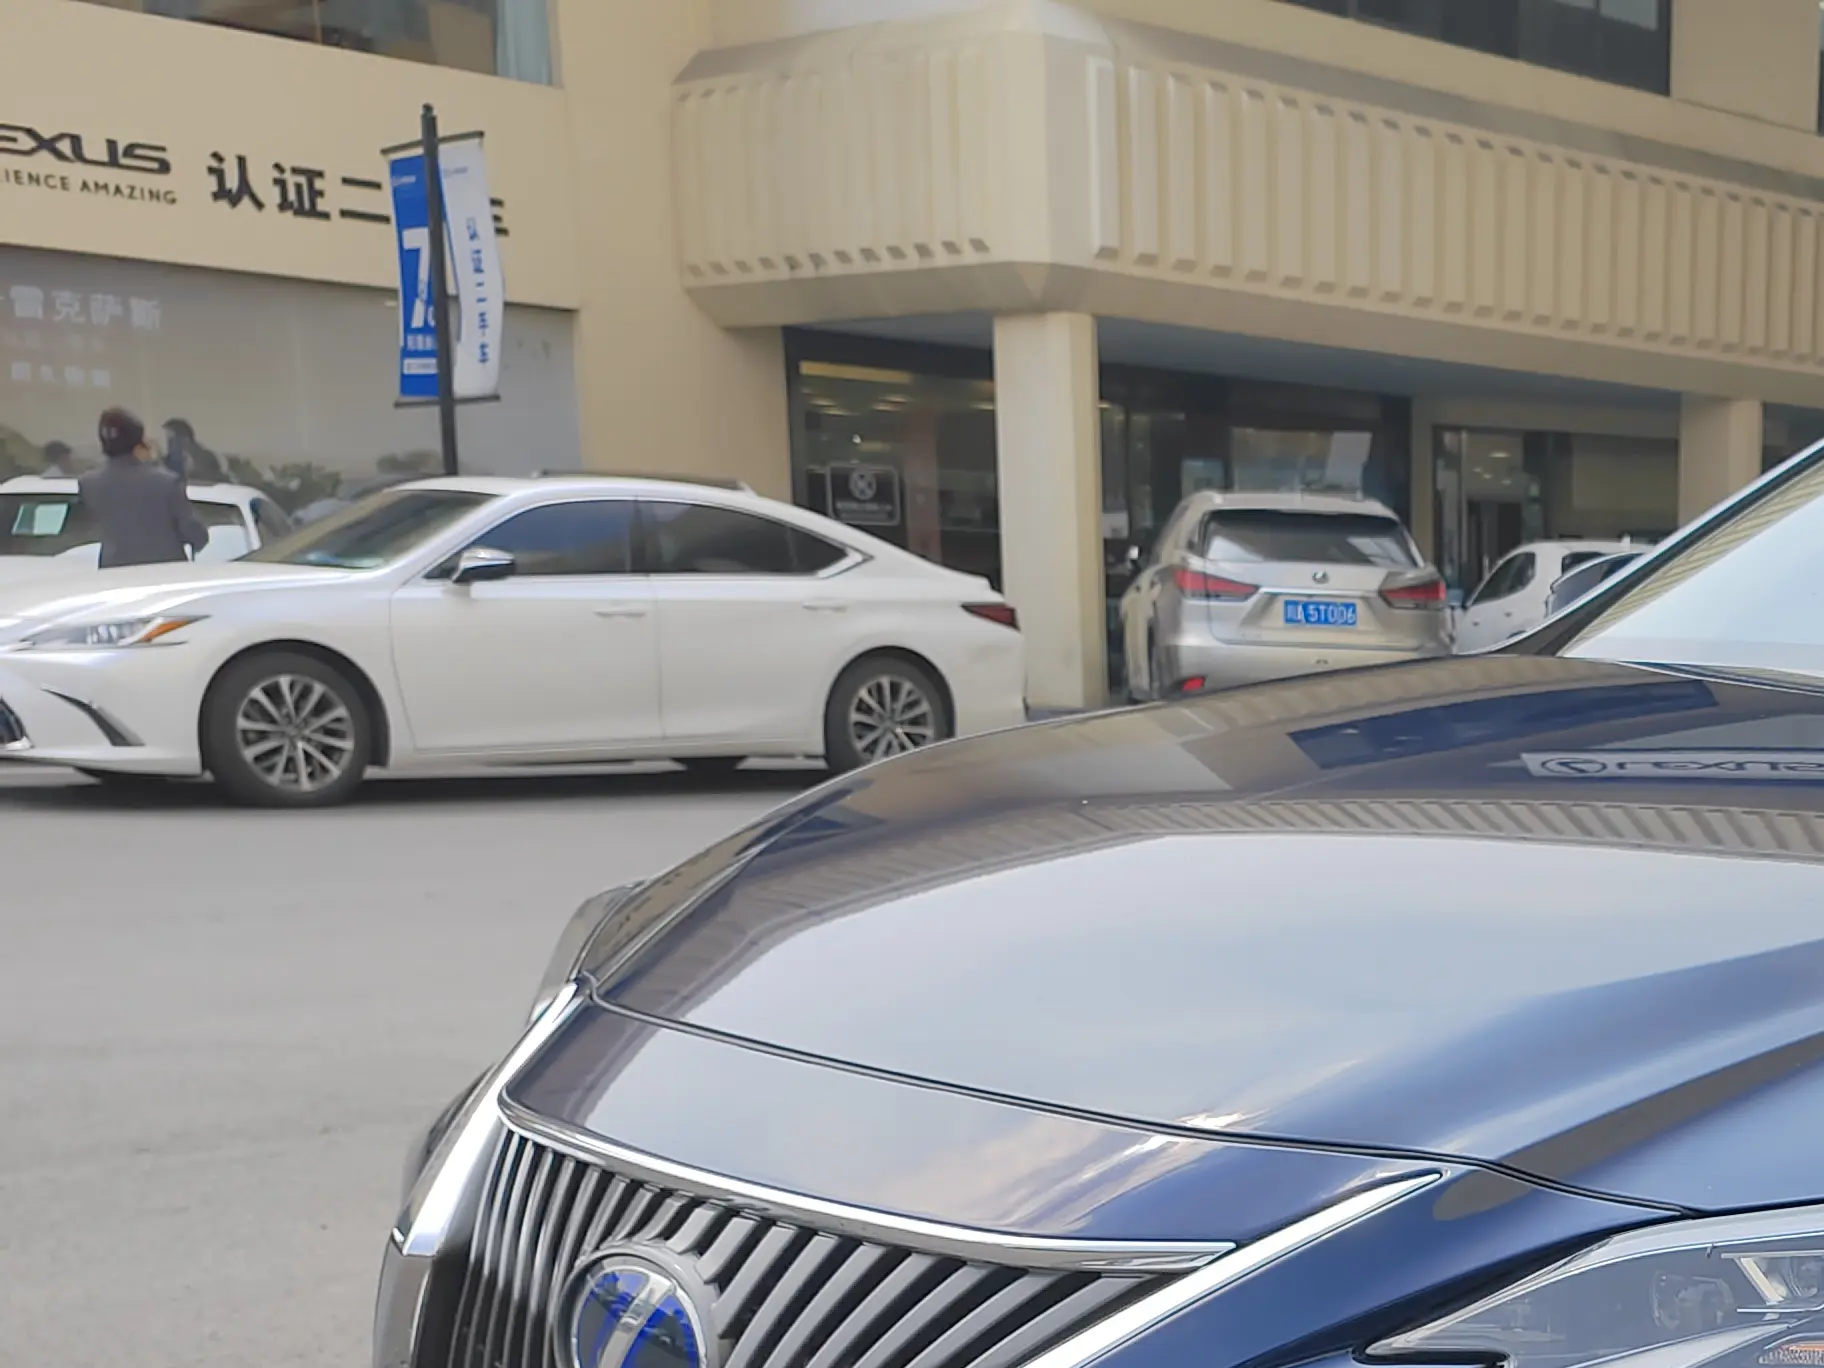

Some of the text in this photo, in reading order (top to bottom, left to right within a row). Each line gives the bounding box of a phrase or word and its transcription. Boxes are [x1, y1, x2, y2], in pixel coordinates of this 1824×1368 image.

[79, 178, 177, 205] AMAZING
[207, 151, 509, 237] 认证二
